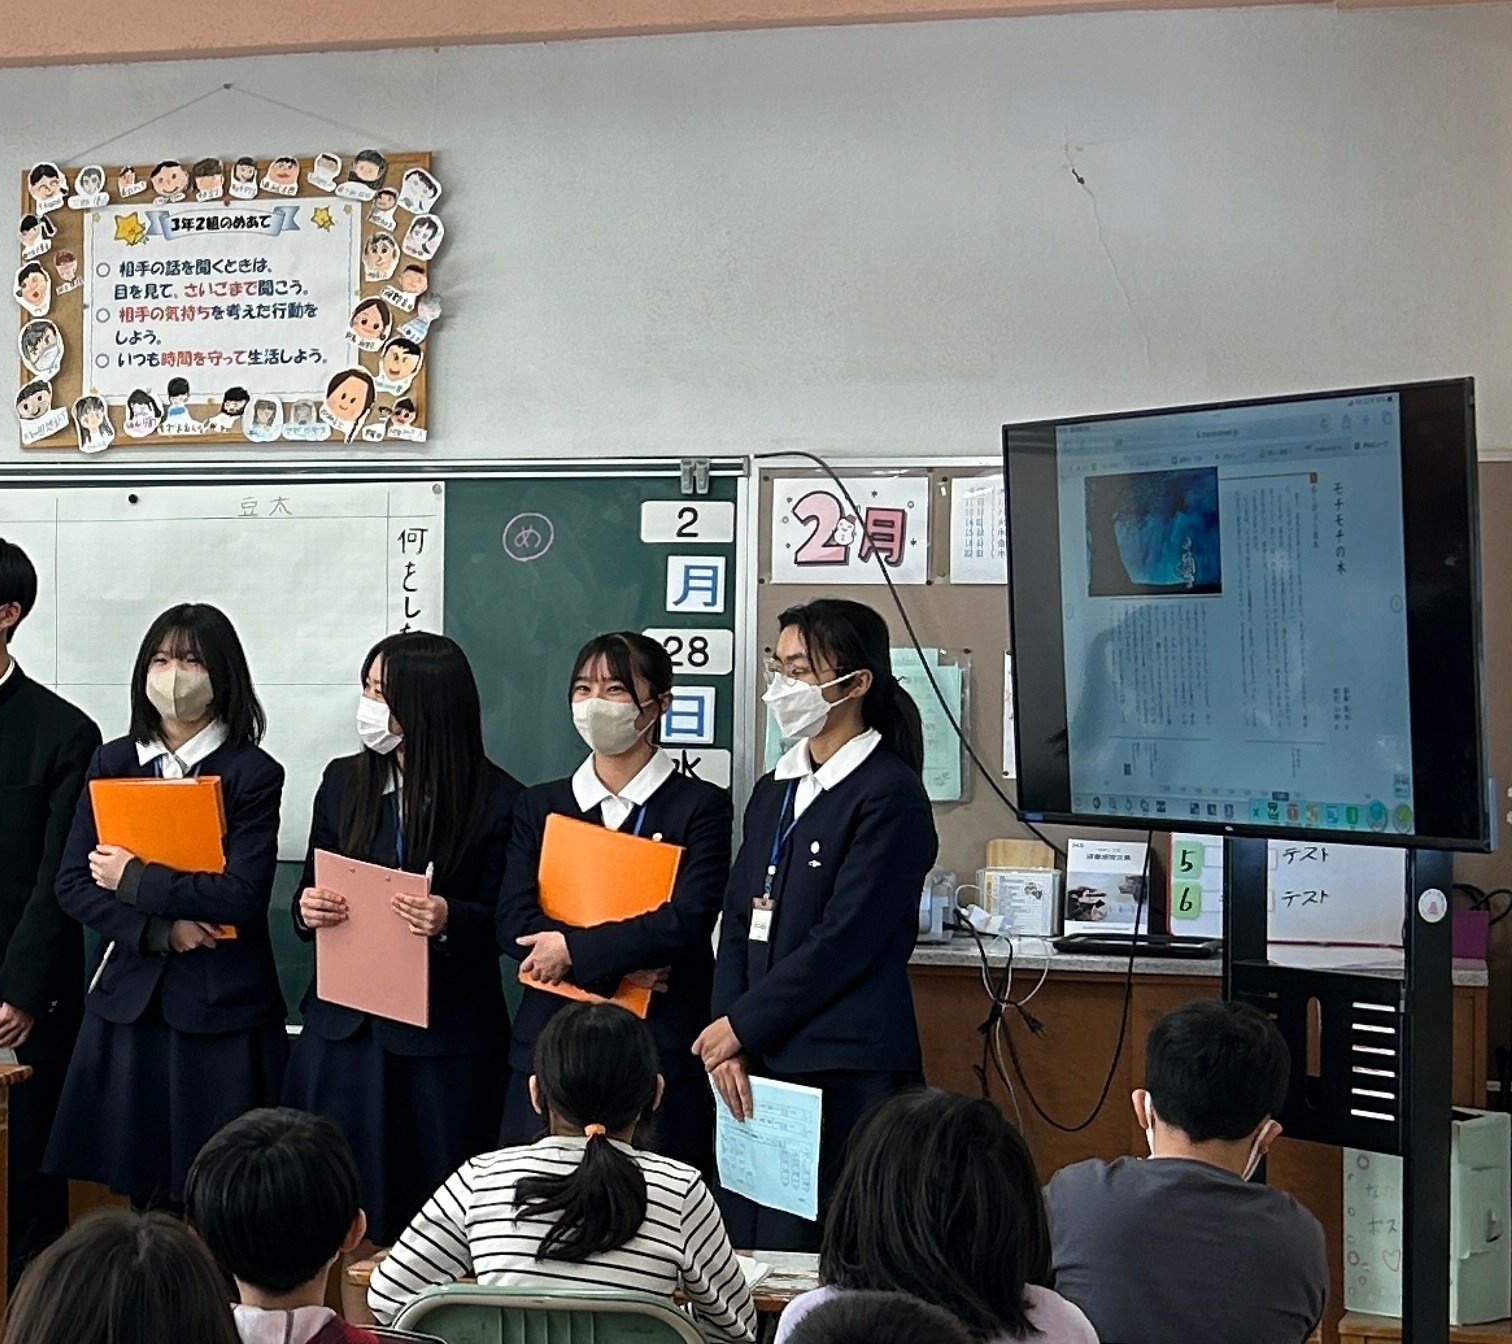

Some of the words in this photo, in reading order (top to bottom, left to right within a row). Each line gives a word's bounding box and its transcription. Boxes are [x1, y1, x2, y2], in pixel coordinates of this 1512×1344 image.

[171, 215, 272, 232] 3年2組のめあて
[119, 303, 318, 323] 相手の気持ちを考えた行動を
[115, 329, 162, 346] しよう。
[118, 349, 328, 367] いつも時間を守って生活しよう。
[239, 496, 294, 517] 豆太
[675, 506, 699, 539] 2
[792, 490, 908, 568] 2月
[397, 528, 428, 634] 何をし
[673, 564, 719, 608] 月
[663, 635, 709, 667] 28
[665, 695, 705, 738] 日
[1180, 849, 1195, 872] 5
[1282, 846, 1329, 864] テスト
[1179, 887, 1193, 911] 6
[1281, 889, 1329, 908] テスト
